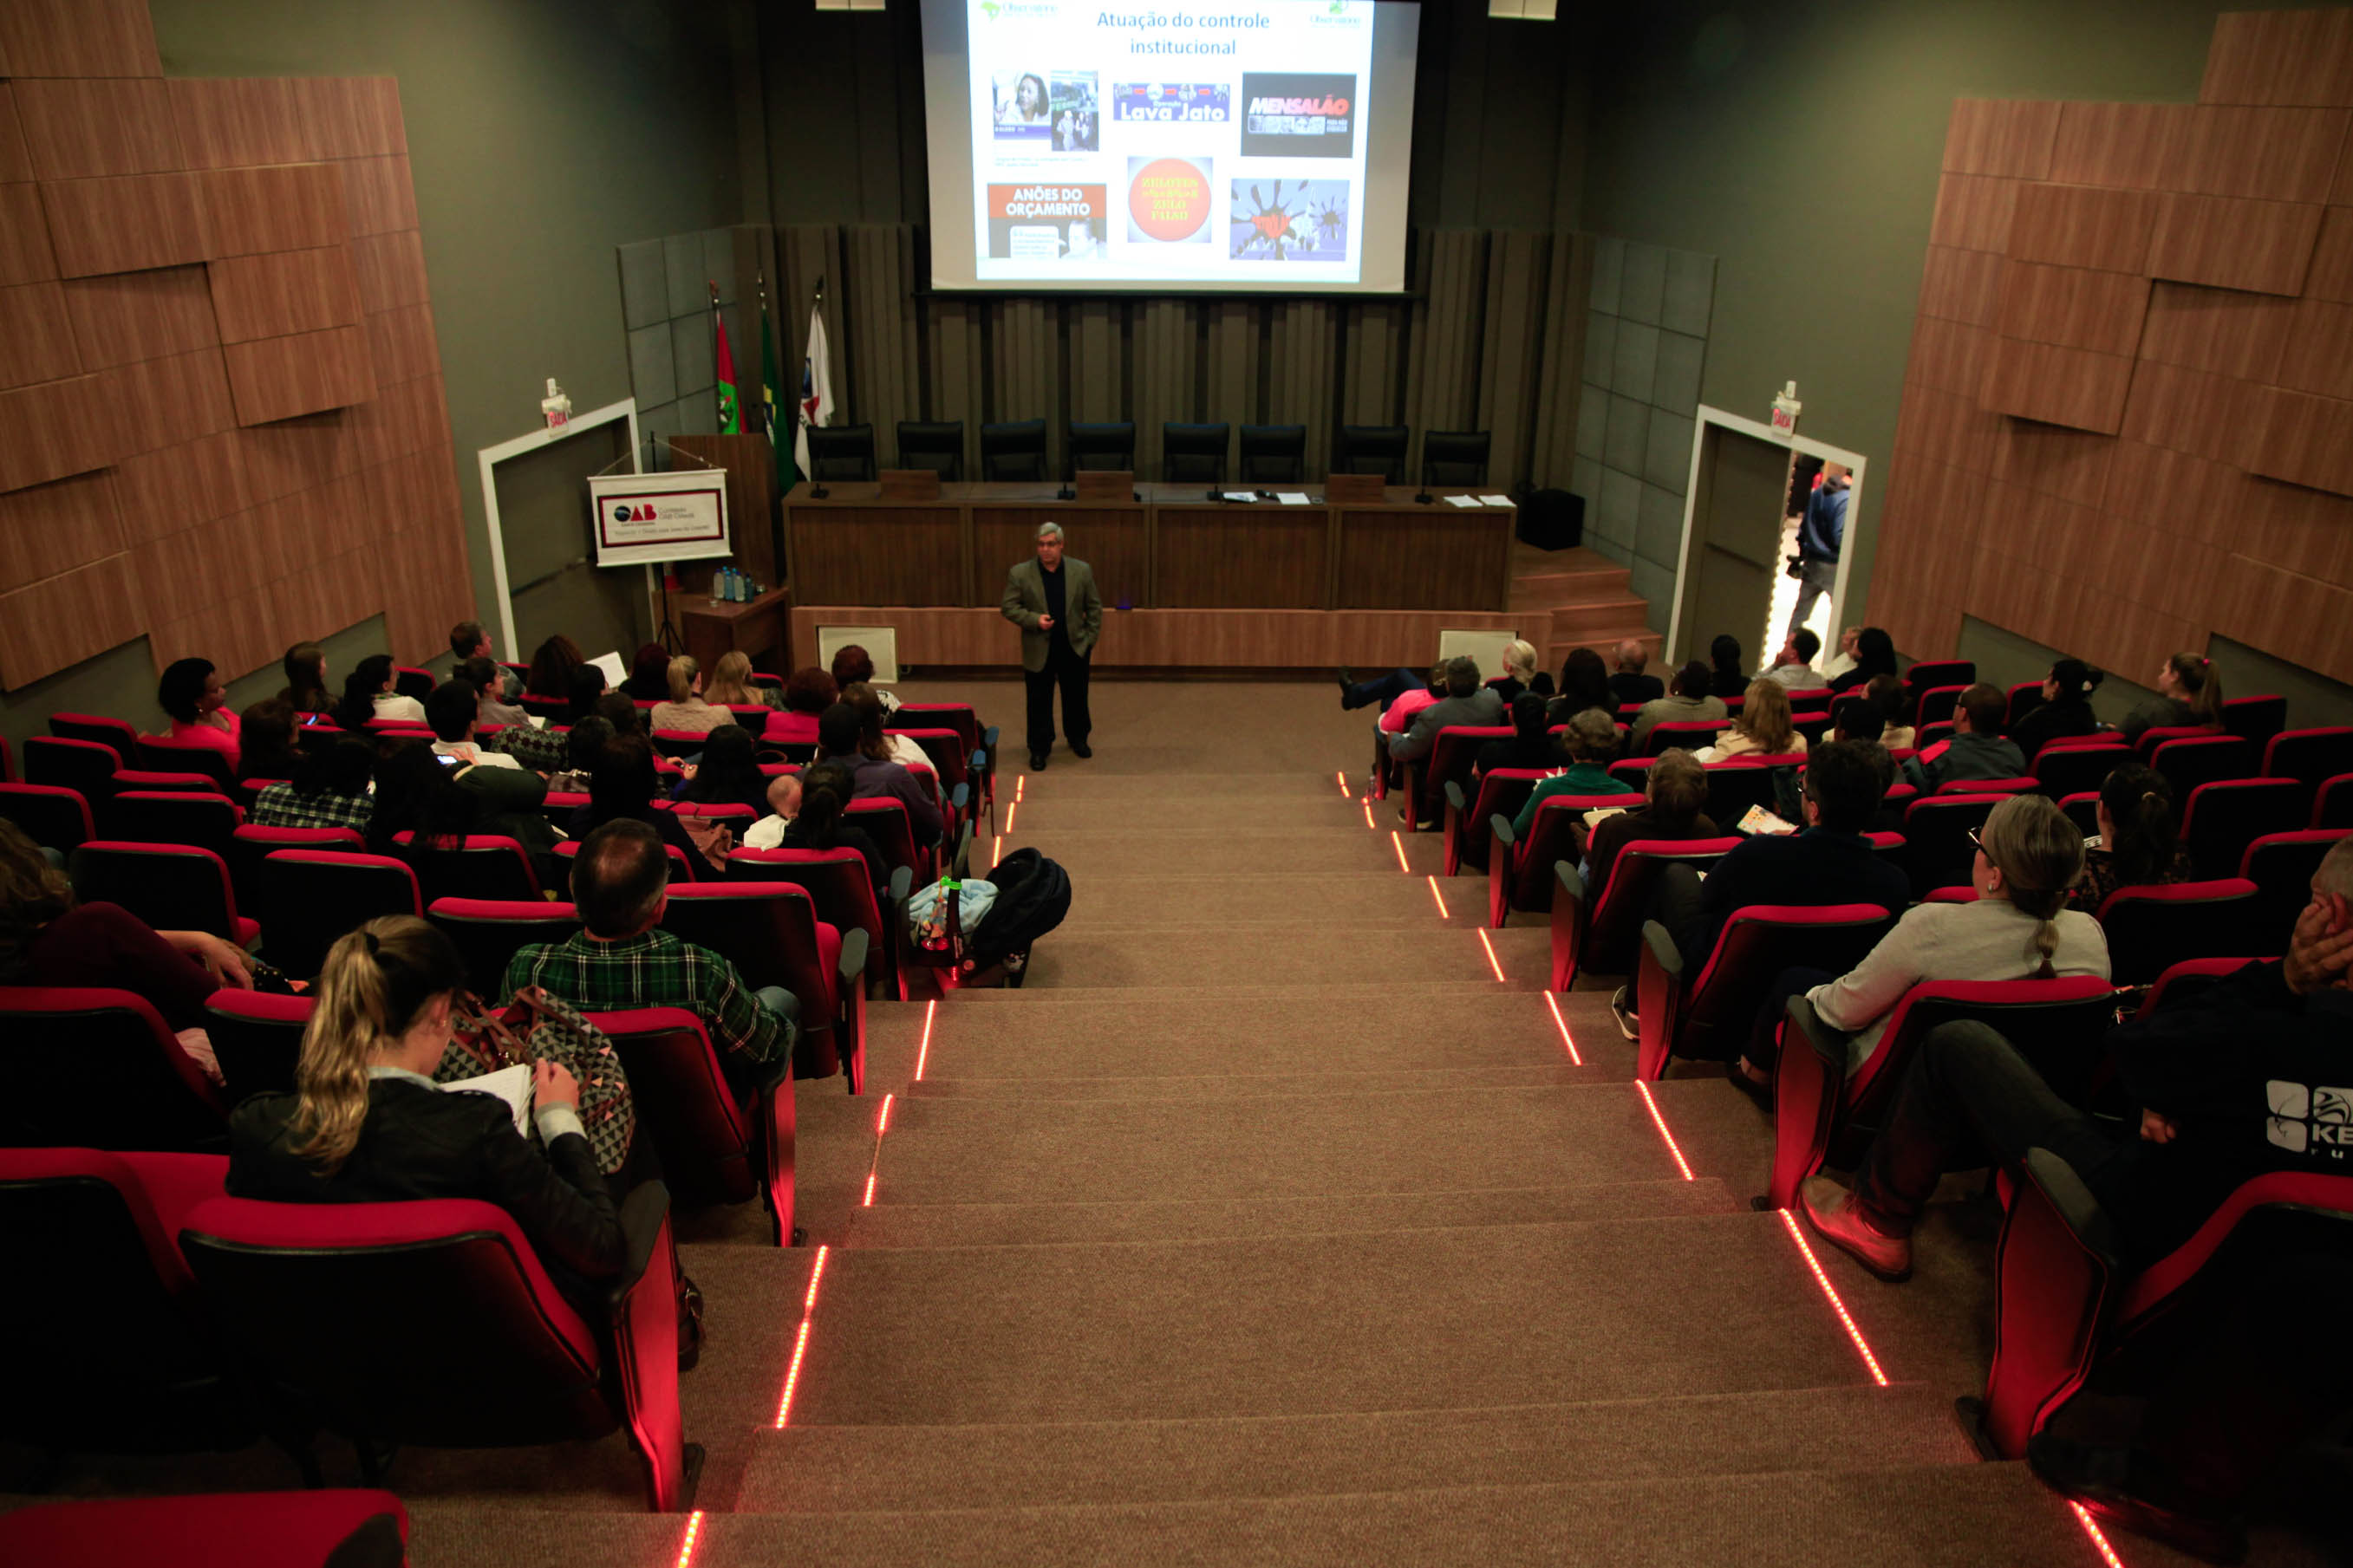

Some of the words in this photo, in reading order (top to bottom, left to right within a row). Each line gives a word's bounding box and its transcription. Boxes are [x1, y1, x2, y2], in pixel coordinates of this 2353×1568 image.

[1097, 11, 1167, 30] Atuação
[1172, 12, 1193, 28] do
[1199, 12, 1270, 28] controle
[1131, 37, 1236, 55] institucional
[1120, 102, 1172, 121] Lava
[1178, 102, 1225, 121] Jato
[1248, 94, 1350, 115] MENSALÃO
[1013, 185, 1059, 201] ANÕES
[1061, 188, 1083, 201] DO
[1005, 203, 1091, 218] ORÇAMENTO
[614, 504, 657, 522] OAB
